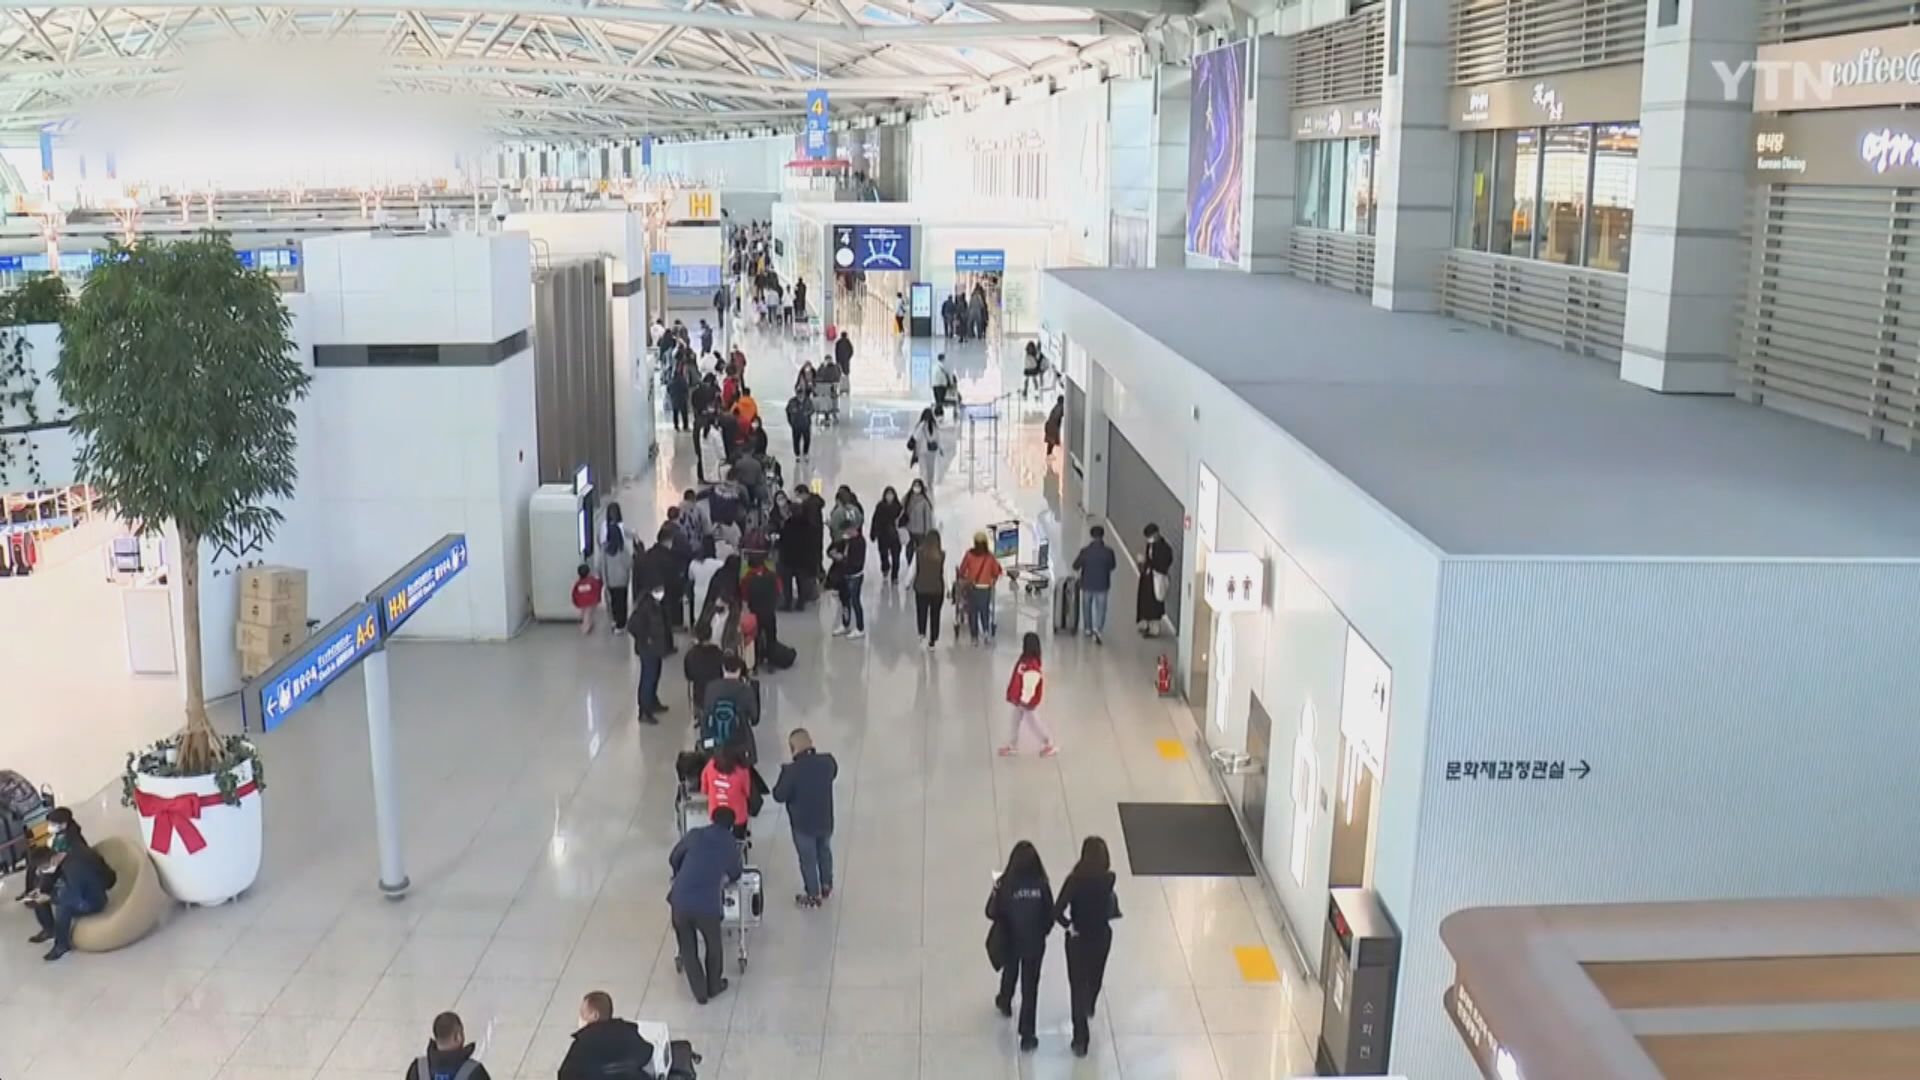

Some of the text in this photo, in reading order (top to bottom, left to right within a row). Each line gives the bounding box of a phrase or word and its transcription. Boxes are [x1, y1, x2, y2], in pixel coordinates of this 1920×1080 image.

[811, 98, 823, 116] 4
[840, 232, 850, 246] 4
[1446, 760, 1565, 781] 문화재감정관실
